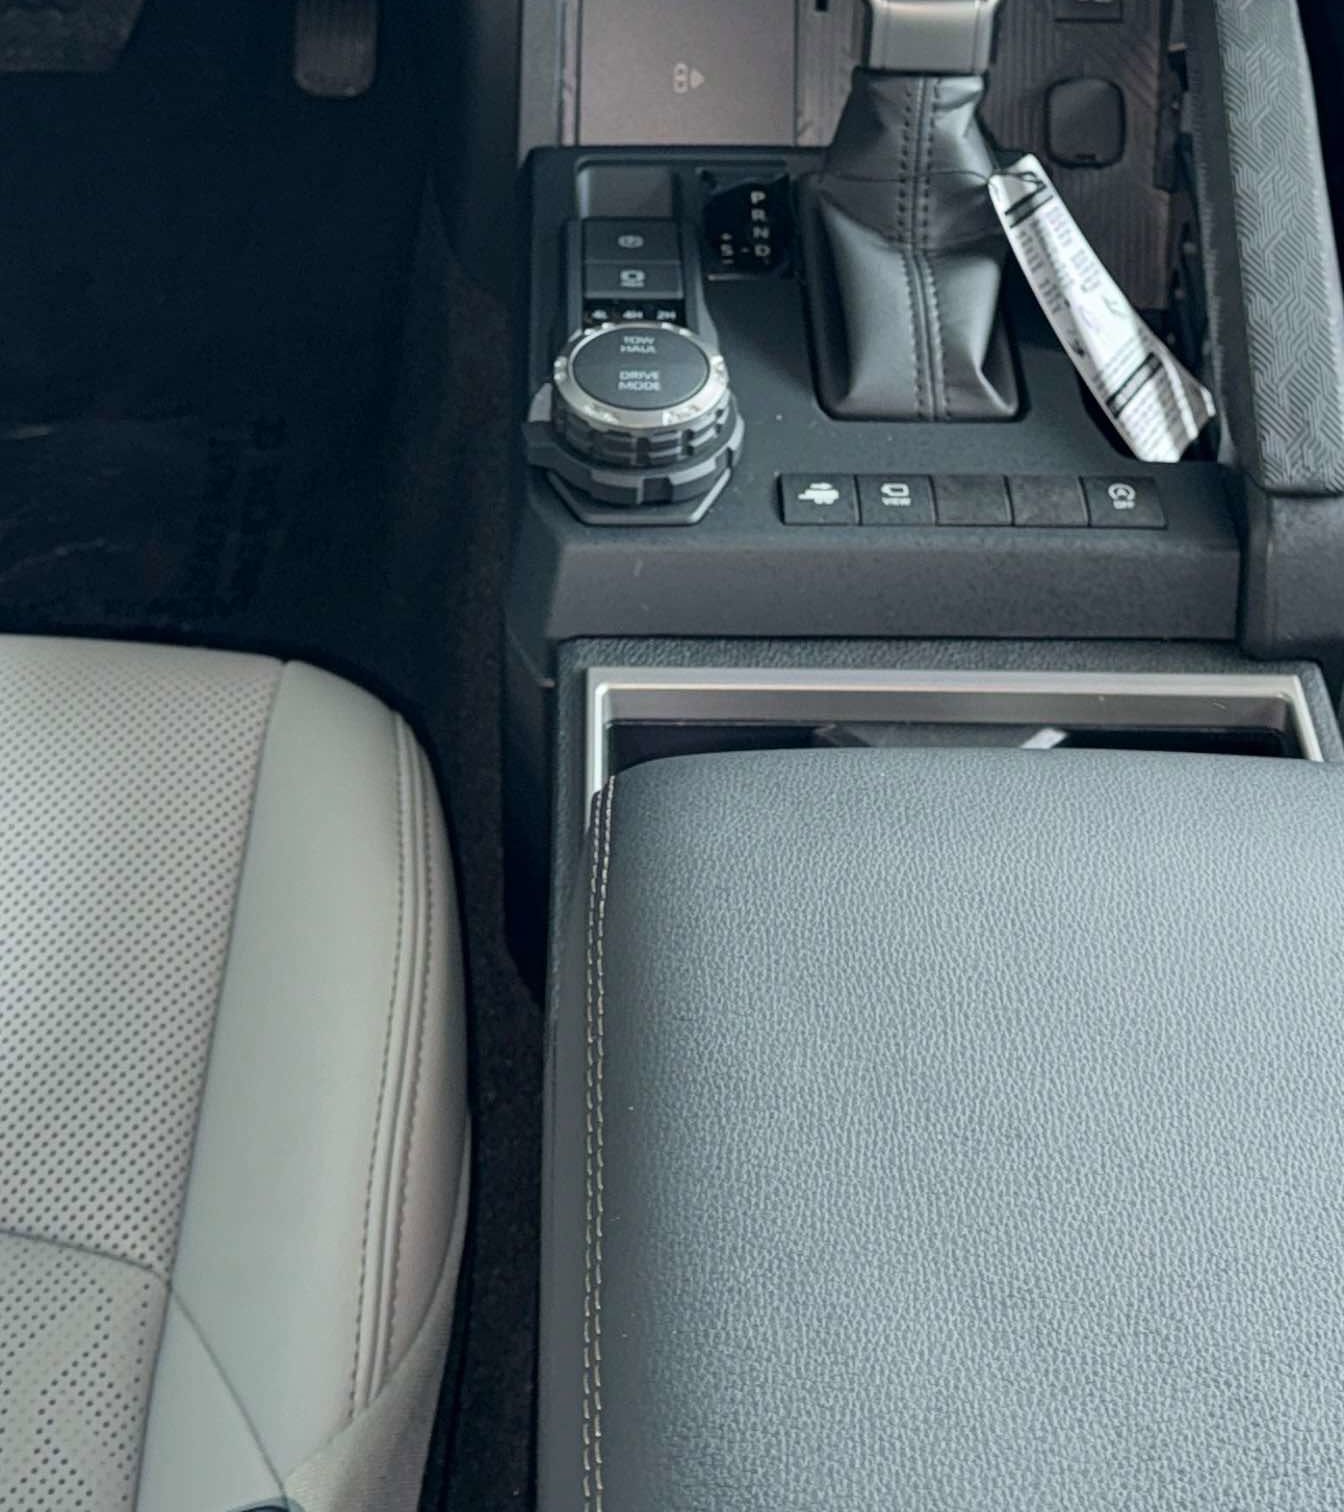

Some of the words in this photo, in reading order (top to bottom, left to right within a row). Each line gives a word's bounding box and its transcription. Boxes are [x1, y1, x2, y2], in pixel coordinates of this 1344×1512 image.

[750, 190, 767, 205] P
[618, 370, 660, 381] DRIVE
[617, 380, 660, 391] MODE
